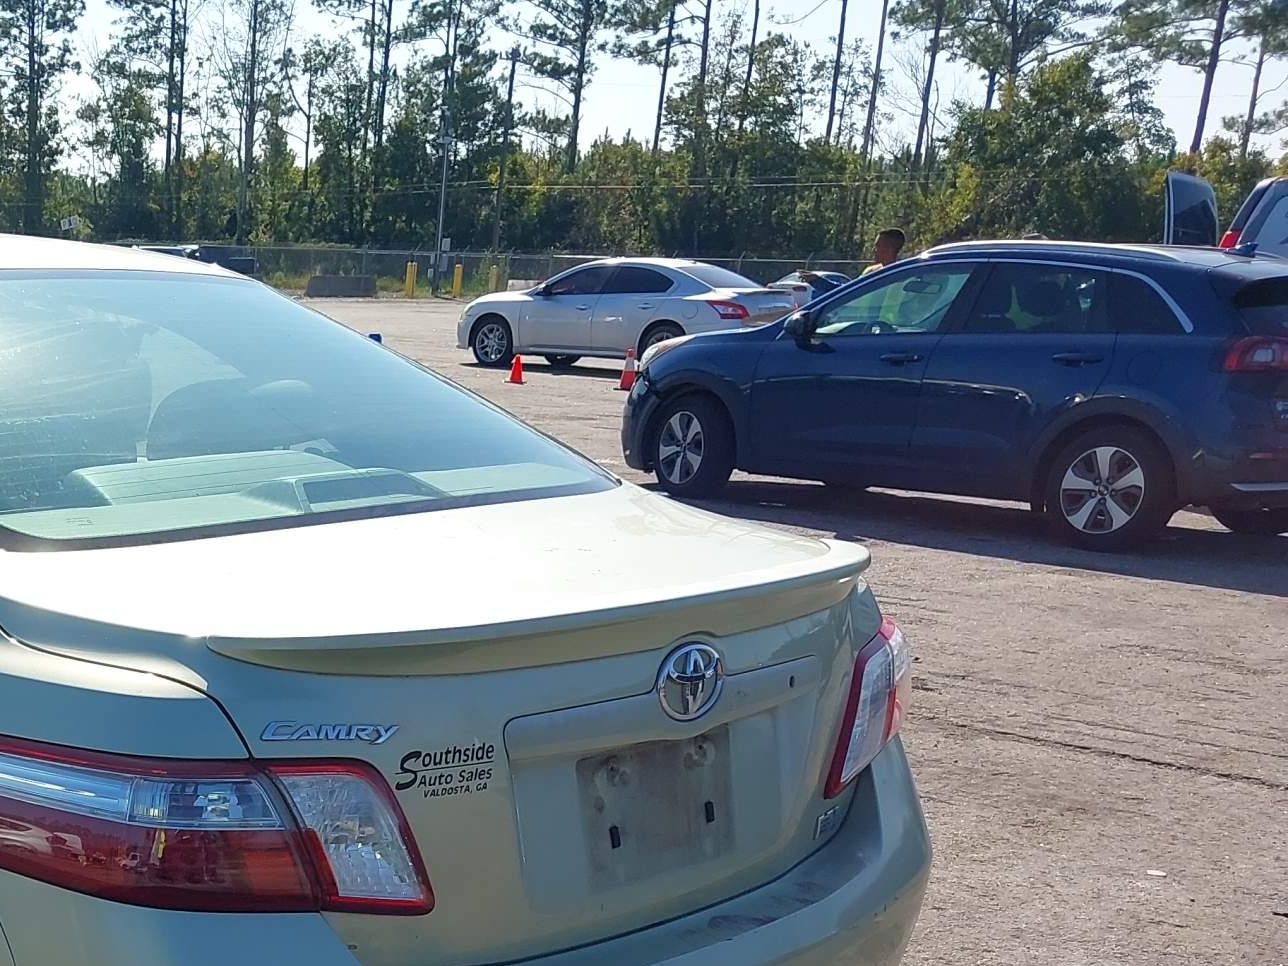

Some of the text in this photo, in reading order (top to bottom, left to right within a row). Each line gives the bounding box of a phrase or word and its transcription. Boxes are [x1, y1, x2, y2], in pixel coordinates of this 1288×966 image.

[260, 720, 400, 745] CAMRY
[395, 742, 495, 791] Southside
[417, 768, 493, 788] Auto Sales
[423, 782, 488, 798] VALDOSTA, GA
